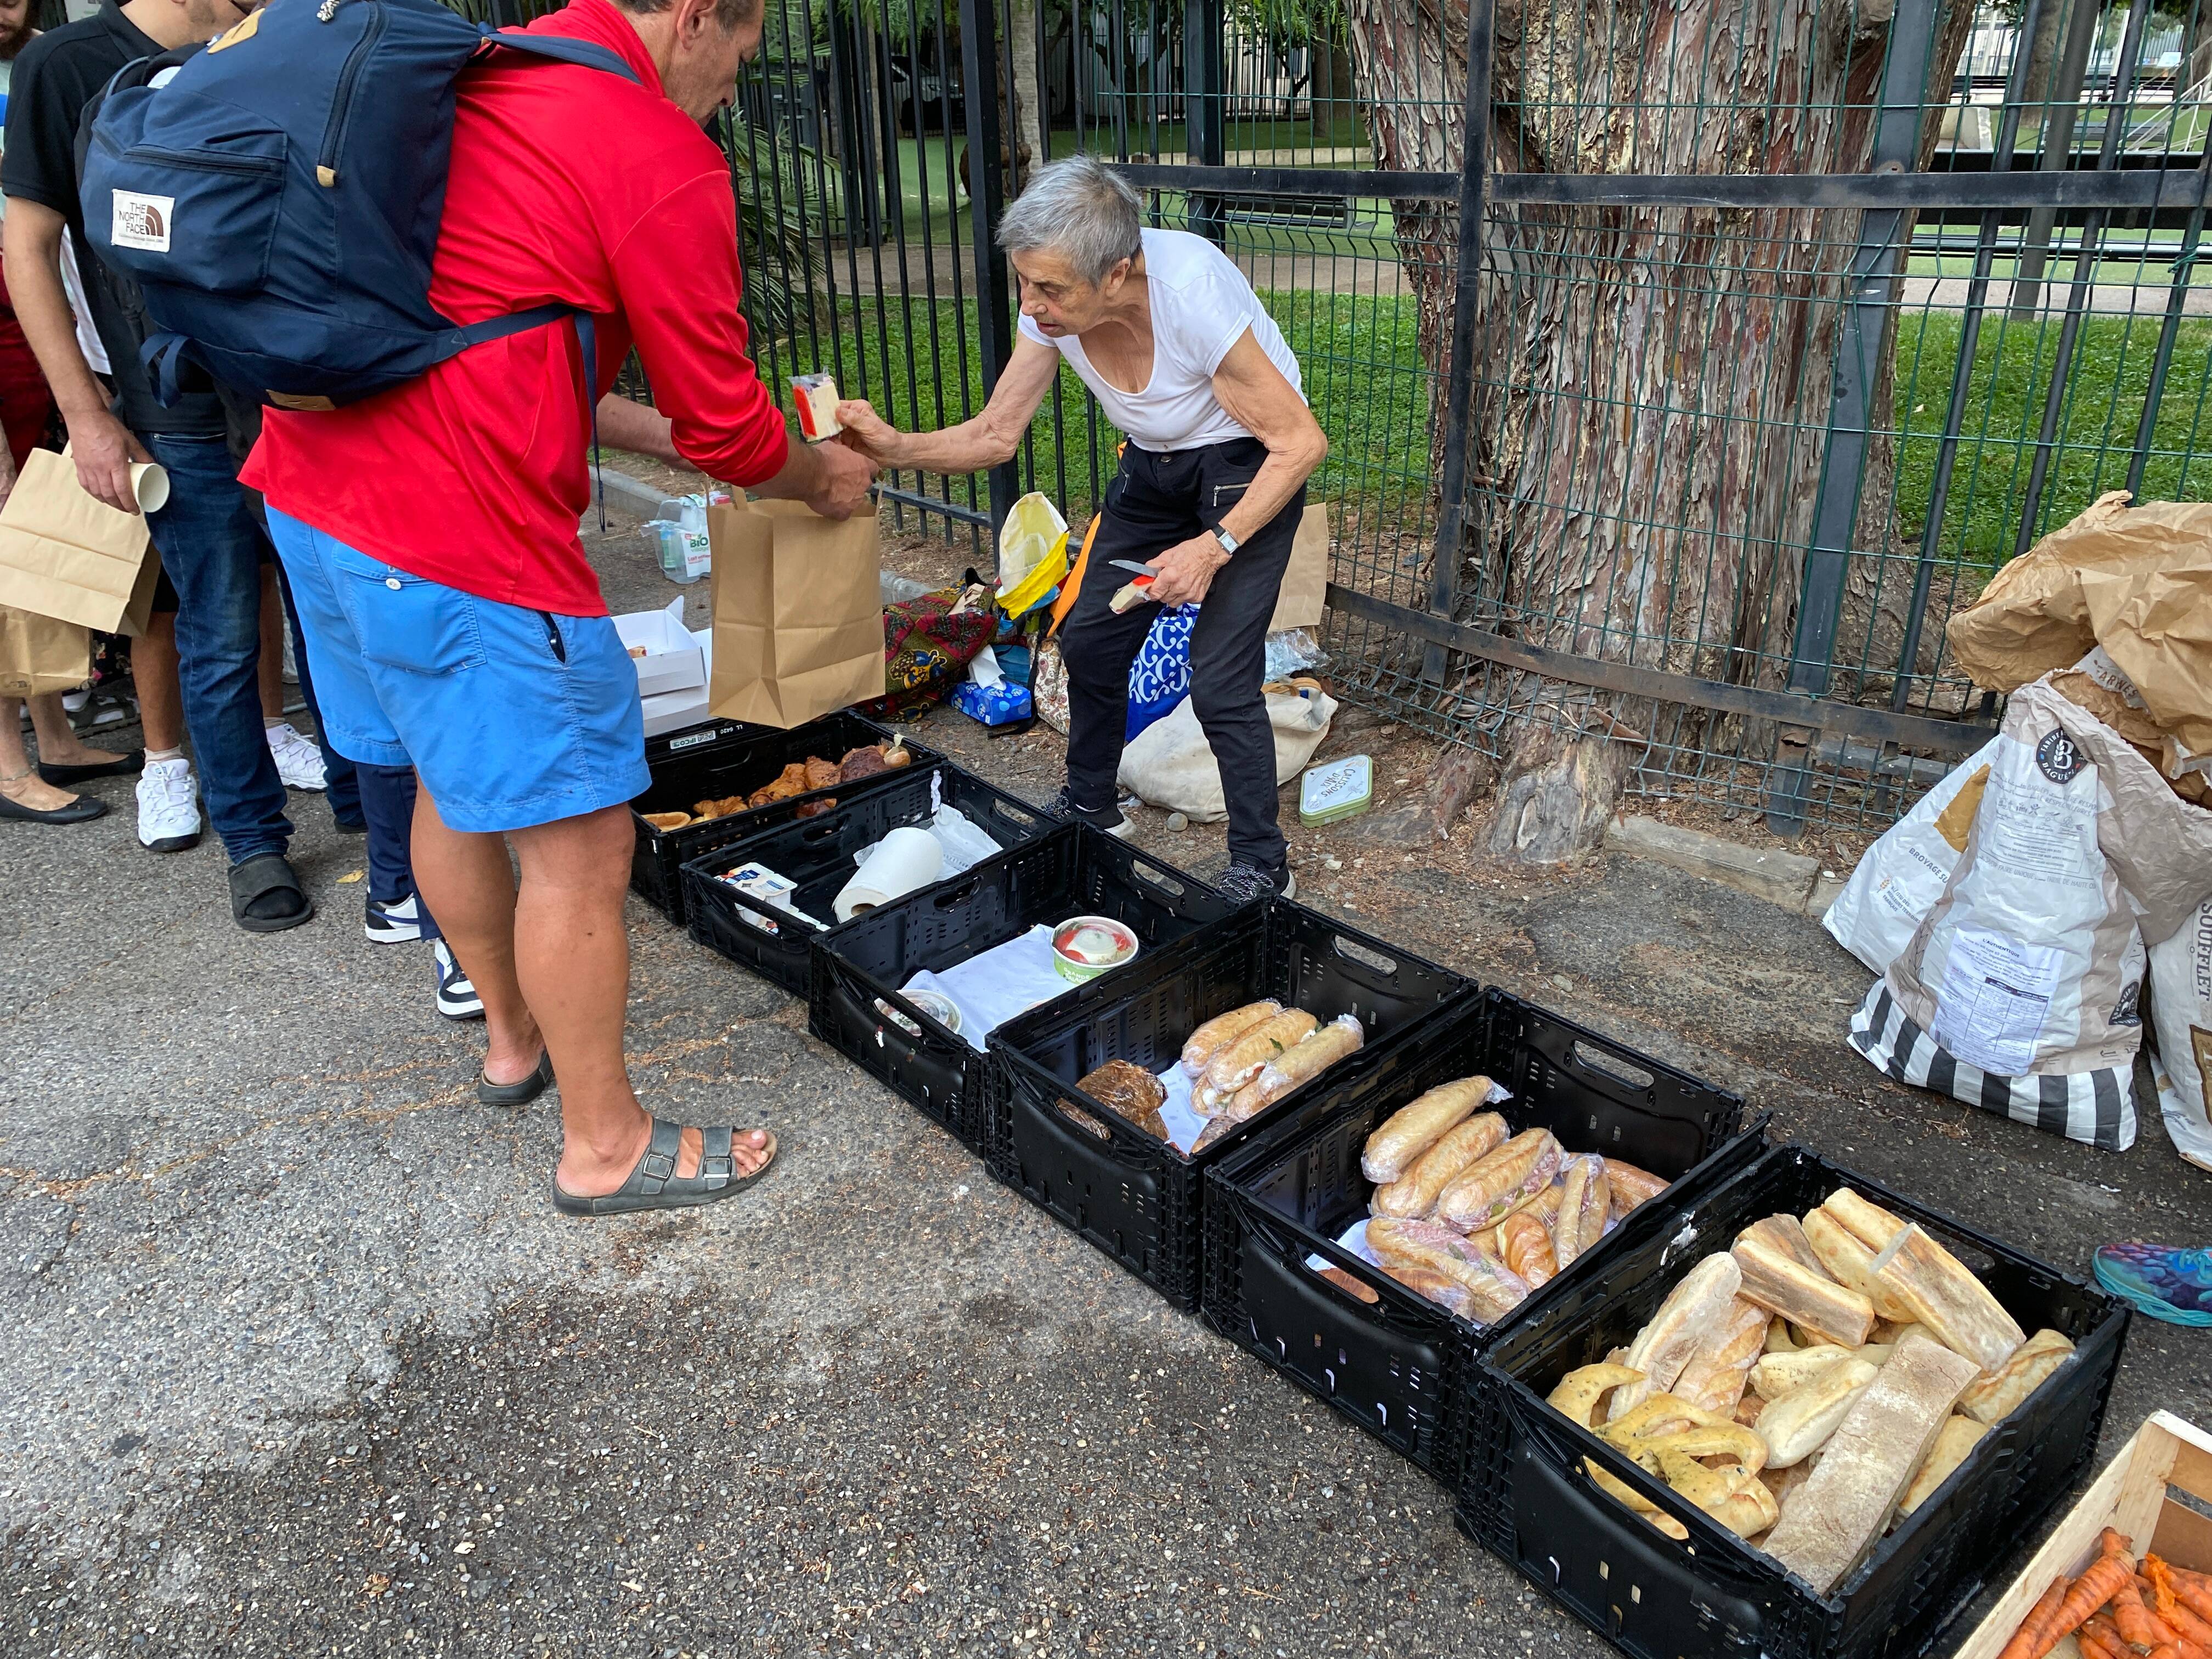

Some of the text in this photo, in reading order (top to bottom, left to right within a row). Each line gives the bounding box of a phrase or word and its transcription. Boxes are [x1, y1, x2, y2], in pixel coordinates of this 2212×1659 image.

[129, 202, 146, 213] THE
[119, 210, 145, 224] NORTH
[126, 222, 145, 235] FACE
[680, 737, 696, 746] IFCO
[1321, 769, 1356, 797] CALISSONS
[1909, 847, 1942, 876] BROYAGE
[1983, 938, 2020, 958] L'AUTHENTIQUE
[2197, 903, 2212, 1001] SOUFFLET
[1063, 967, 1090, 980] GRANDE
